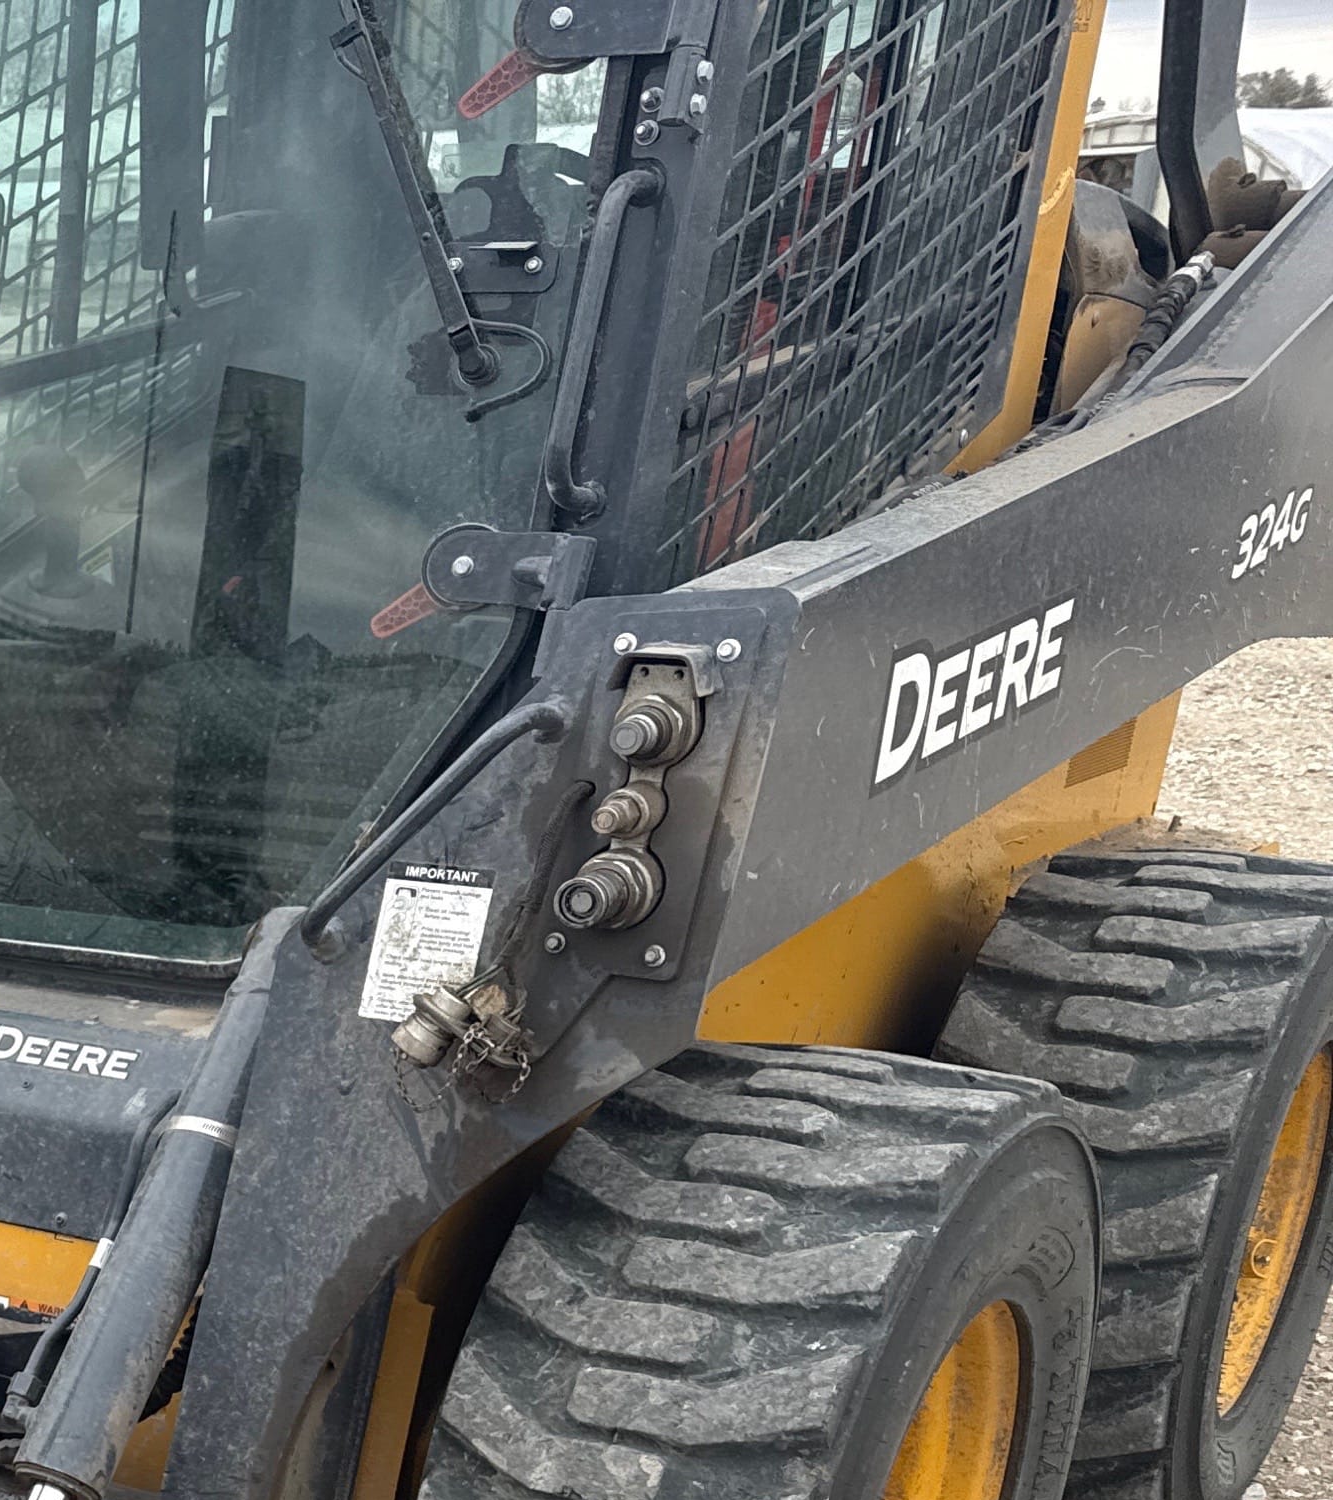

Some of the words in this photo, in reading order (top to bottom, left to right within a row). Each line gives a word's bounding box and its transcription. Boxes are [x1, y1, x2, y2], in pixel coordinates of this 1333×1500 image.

[1231, 487, 1313, 579] 324G
[874, 598, 1075, 785] DEERE
[405, 865, 479, 884] IMPORTANT
